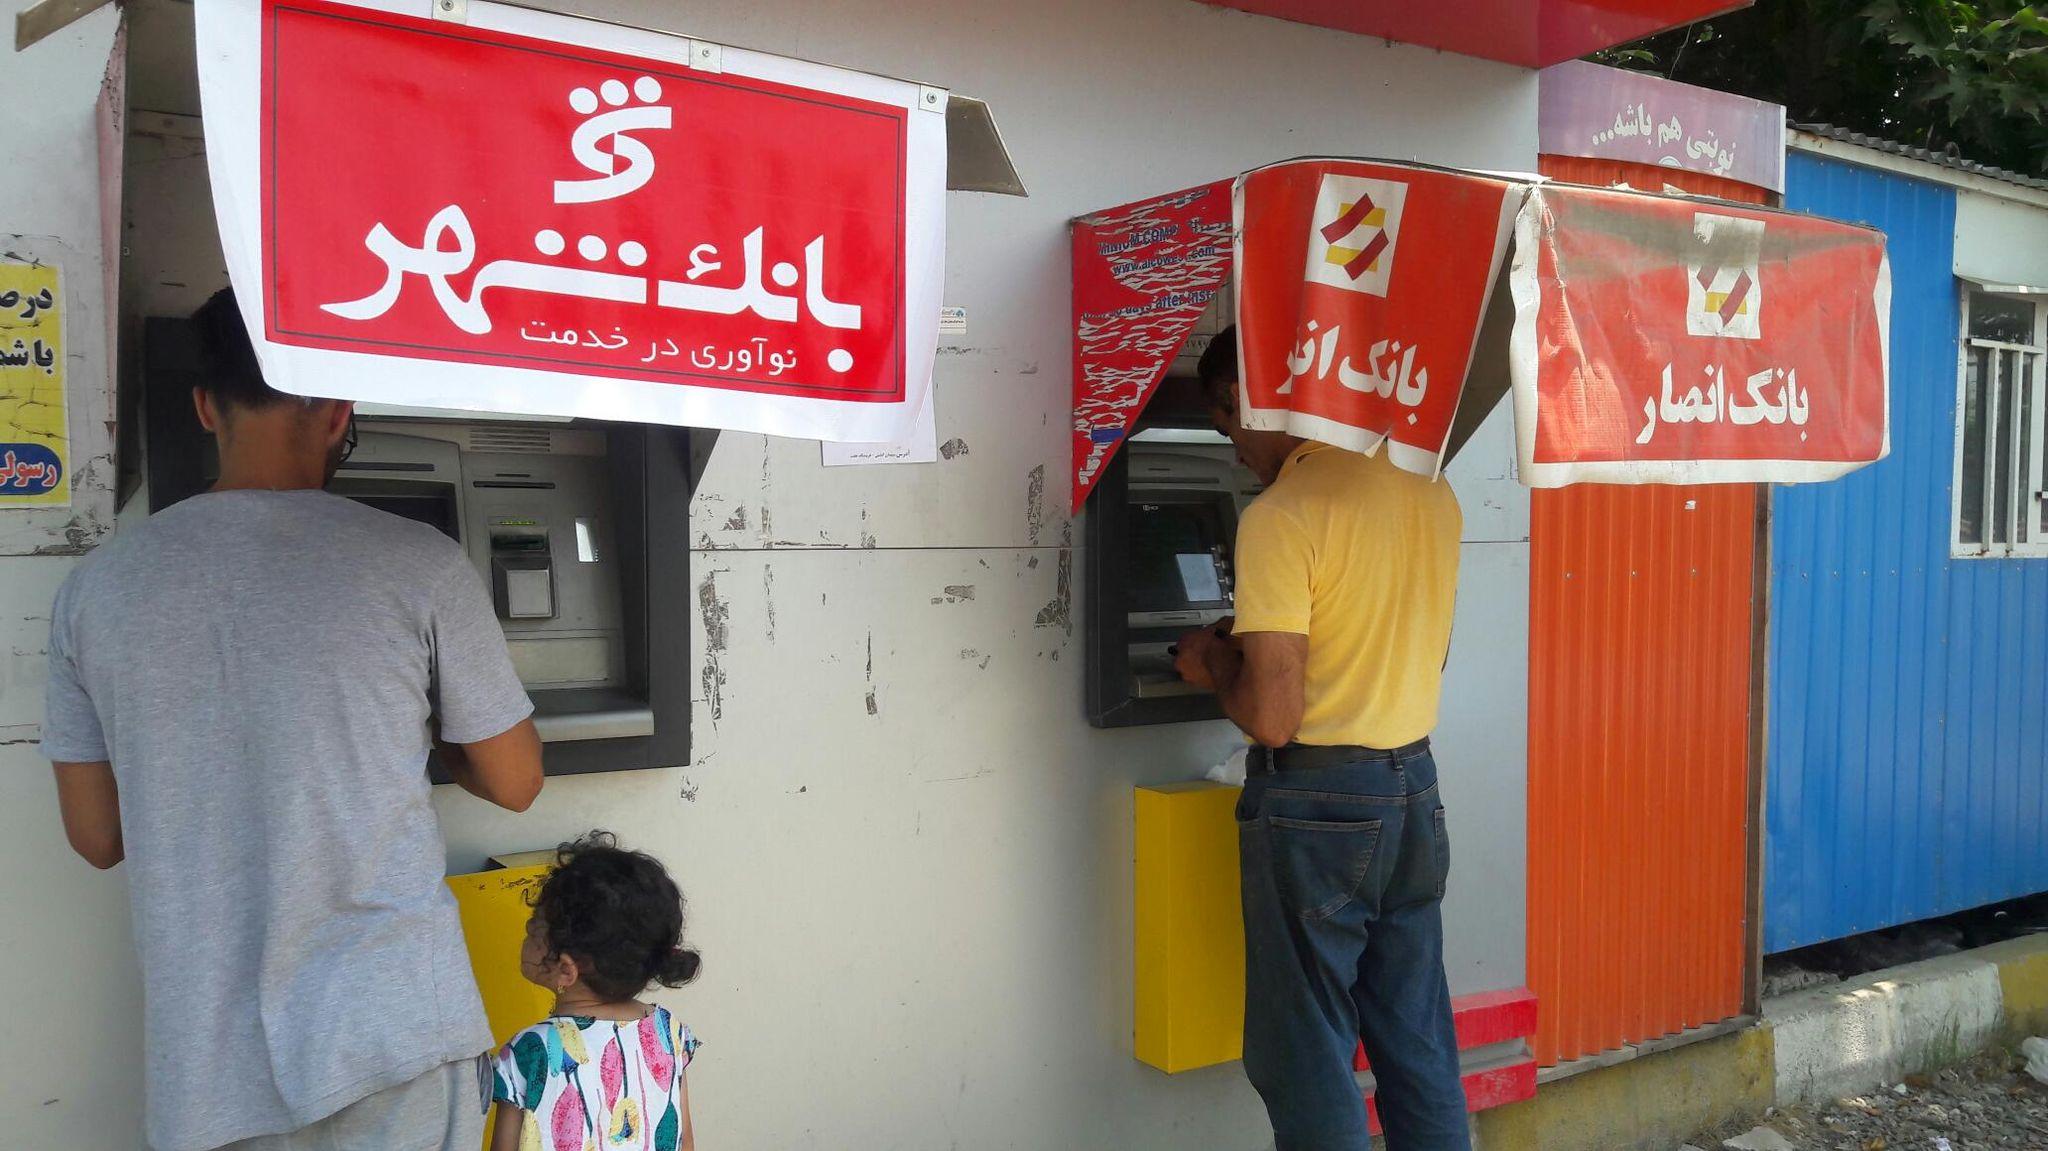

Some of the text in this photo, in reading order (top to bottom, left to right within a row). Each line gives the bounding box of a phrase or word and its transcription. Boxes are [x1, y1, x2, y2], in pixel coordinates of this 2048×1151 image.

[1657, 115, 1682, 147] هم
[1686, 130, 1737, 175] نوبتی
[320, 204, 648, 335] شهر
[520, 319, 799, 376] نوآوری در خدمت
[1338, 339, 1429, 426] بانک
[1635, 361, 1809, 445] بانک انصار
